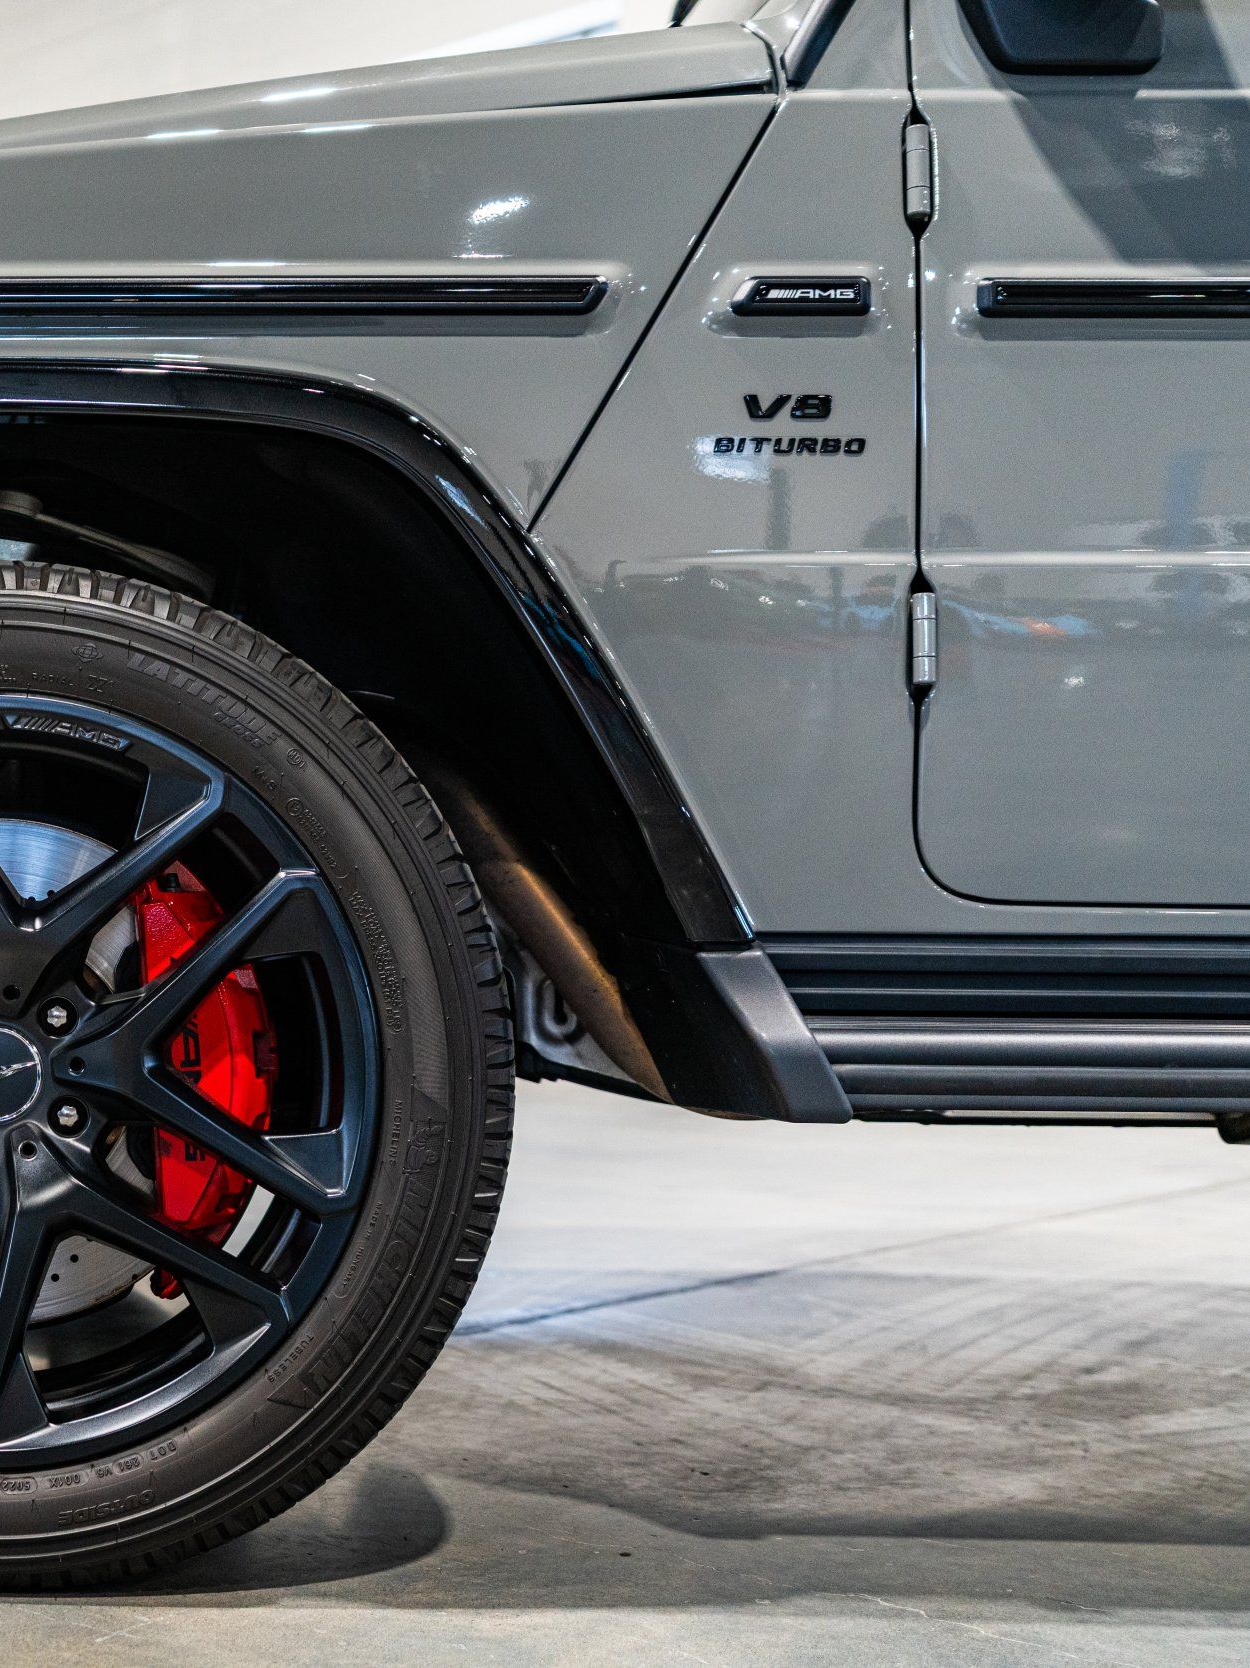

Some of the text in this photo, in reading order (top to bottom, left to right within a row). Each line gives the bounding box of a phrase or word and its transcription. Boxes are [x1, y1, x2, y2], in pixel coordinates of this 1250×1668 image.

[796, 288, 855, 299] AMG
[744, 395, 833, 420] V8
[714, 437, 866, 454] BITURBO
[125, 650, 283, 748] LATITUDE
[50, 722, 122, 748] AMG
[387, 1099, 404, 1159] MICHELIN
[307, 1178, 435, 1395] MICHELIN
[264, 1331, 315, 1384] TUBELESS
[148, 1440, 177, 1461] DOT
[0, 1479, 31, 1492] 5022
[57, 1488, 157, 1526] OUTSIDE
